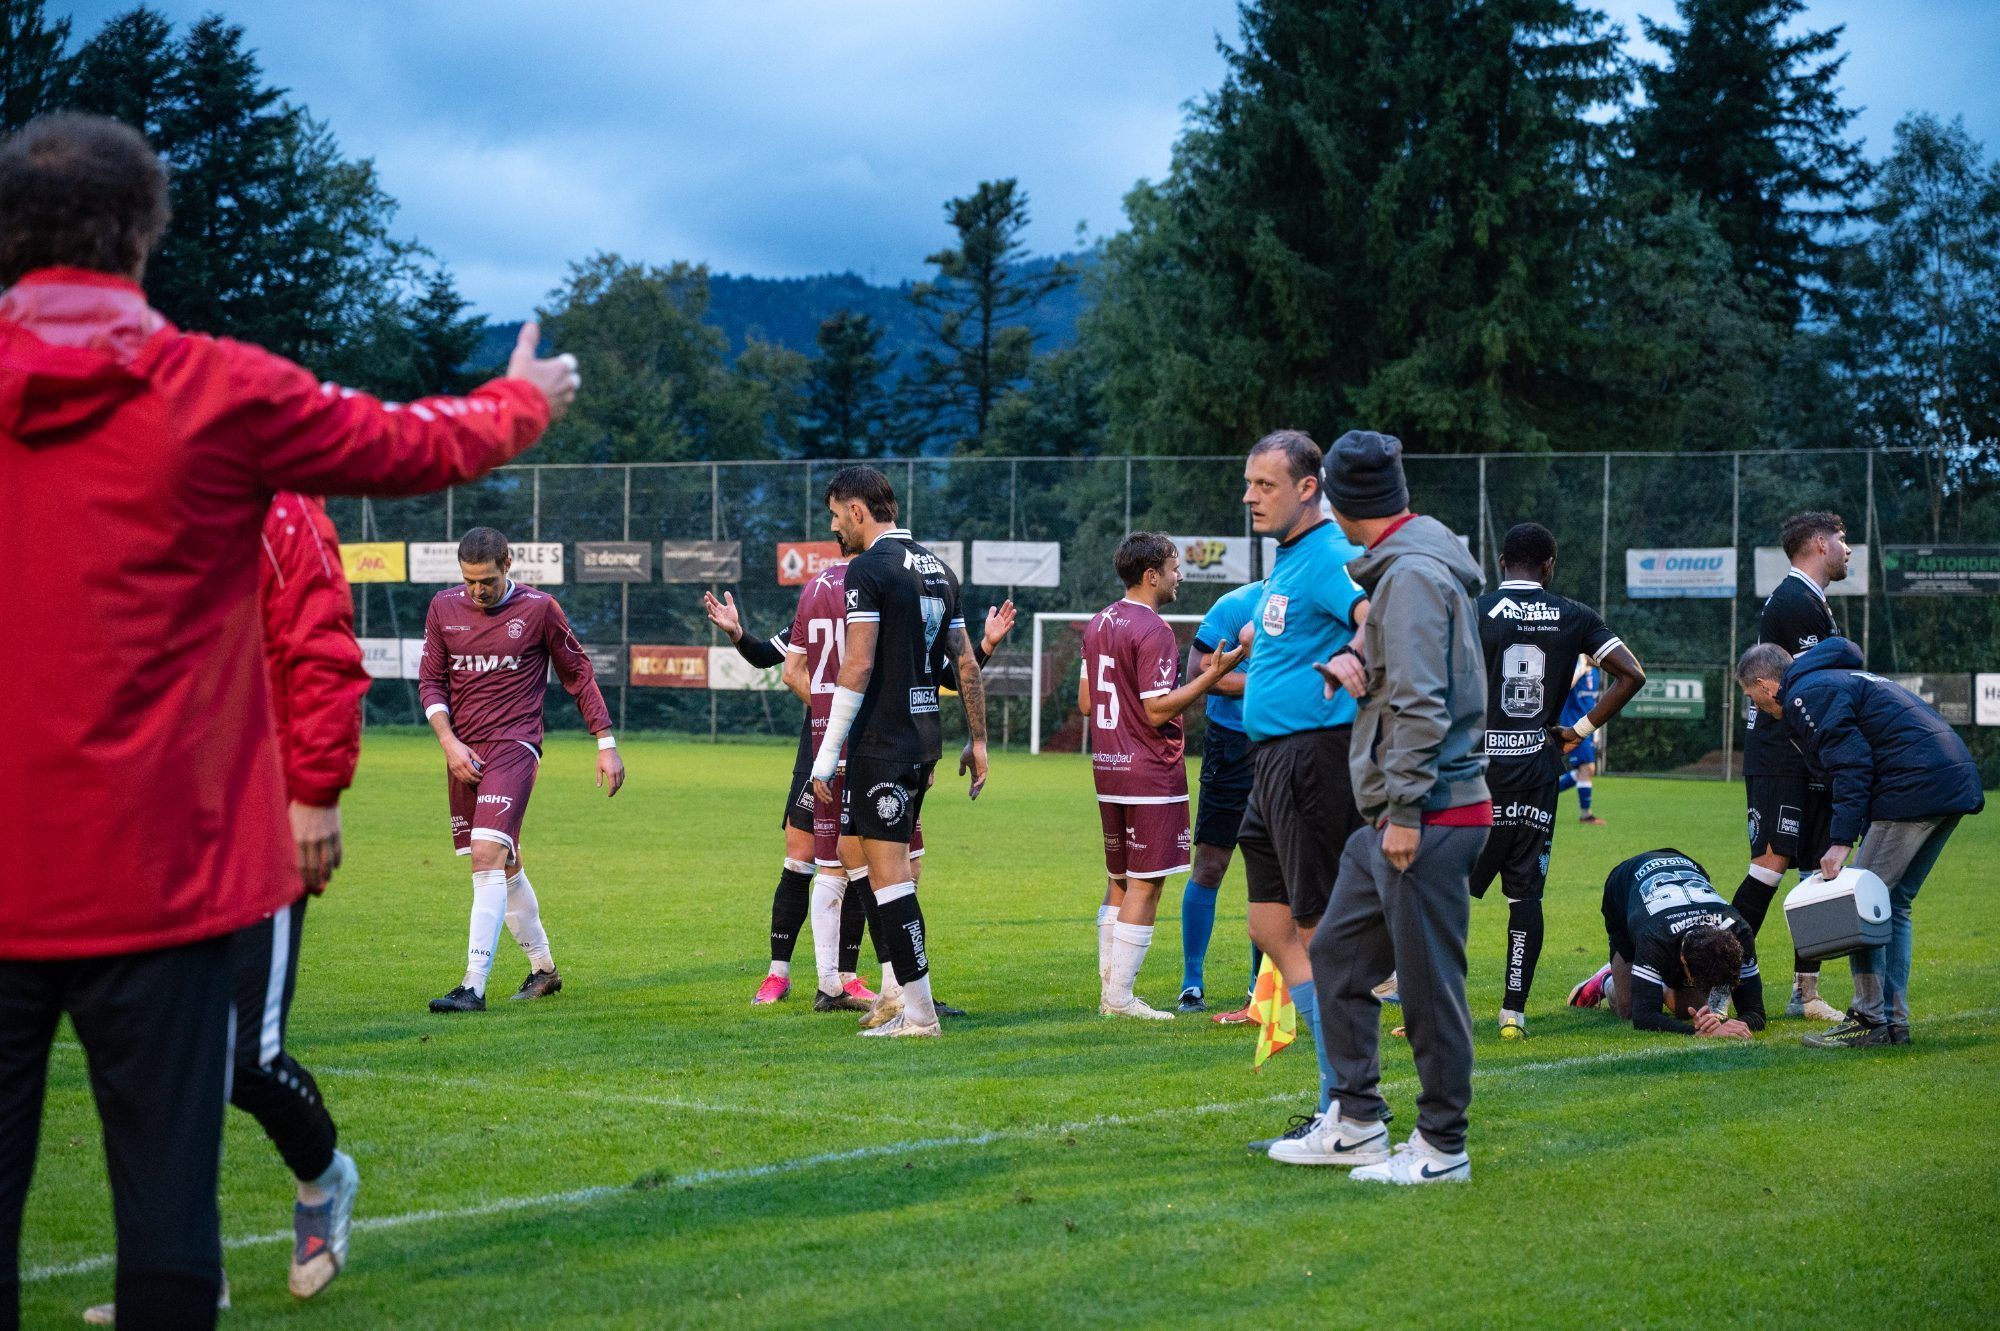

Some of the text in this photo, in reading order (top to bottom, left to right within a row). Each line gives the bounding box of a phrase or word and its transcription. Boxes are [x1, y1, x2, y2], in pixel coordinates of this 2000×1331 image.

[1520, 602, 1547, 611] Fetz
[1097, 654, 1119, 729] 5
[1501, 643, 1546, 718] 8
[470, 949, 491, 957] JAKO
